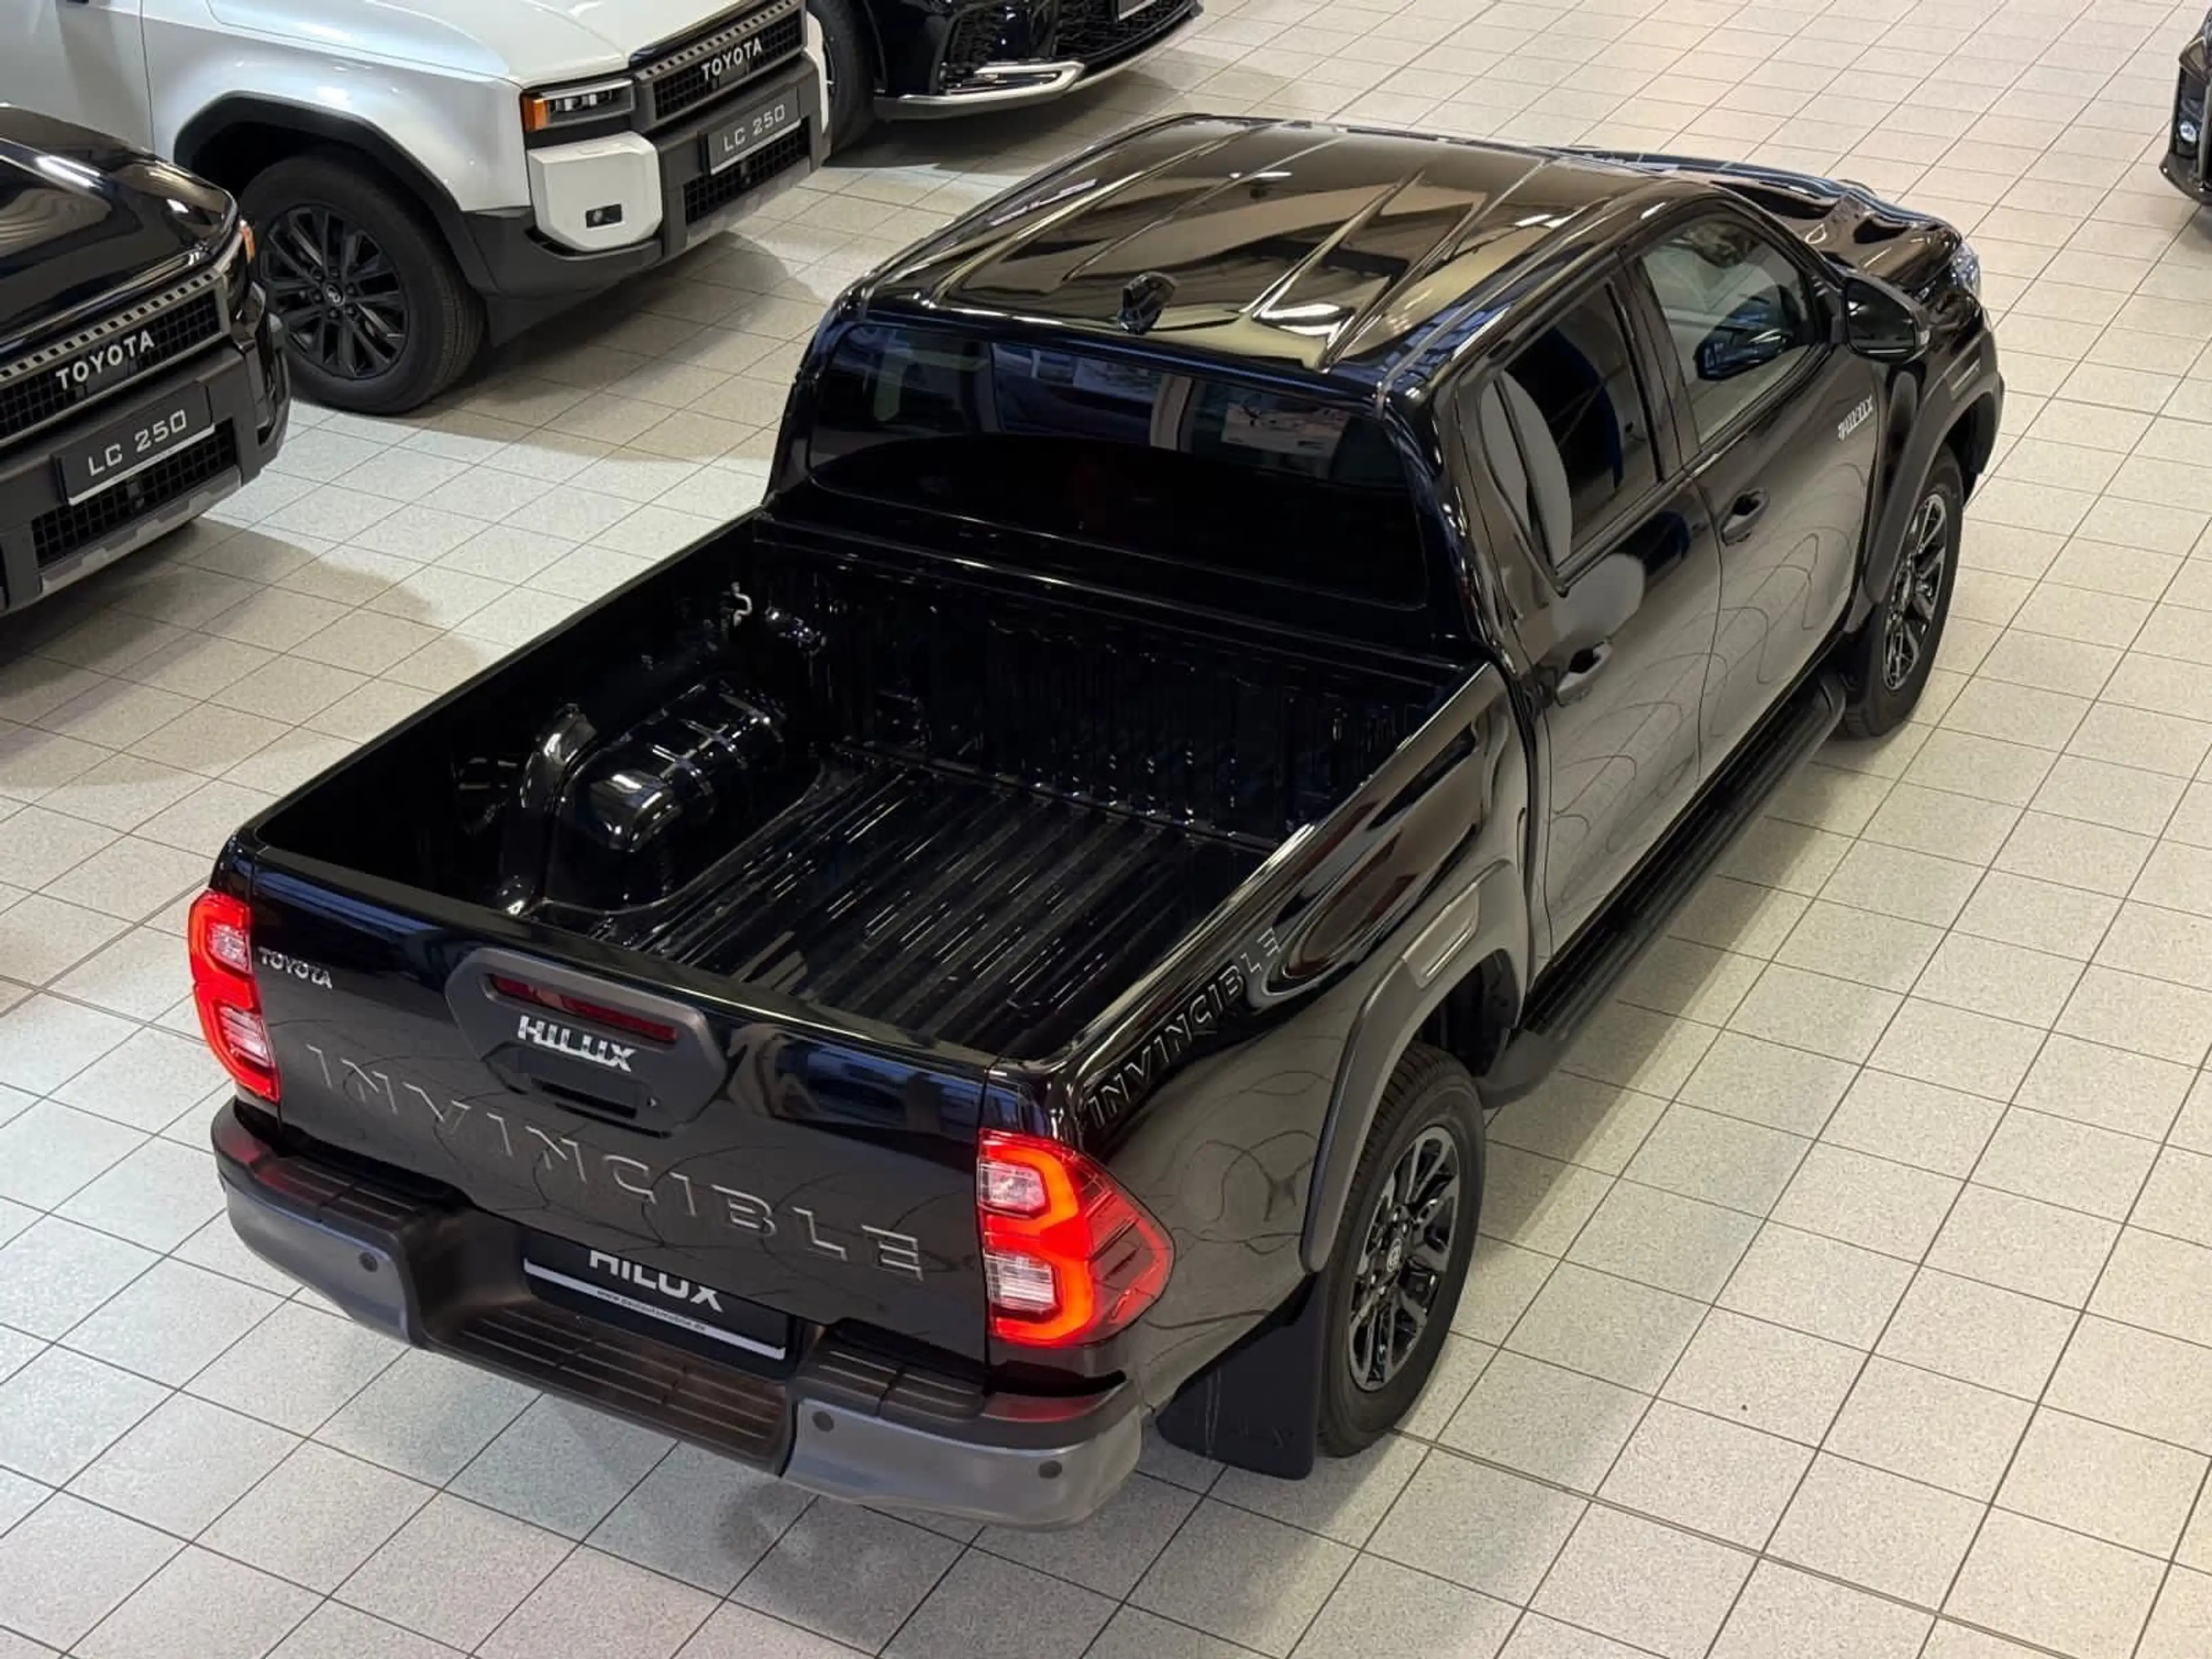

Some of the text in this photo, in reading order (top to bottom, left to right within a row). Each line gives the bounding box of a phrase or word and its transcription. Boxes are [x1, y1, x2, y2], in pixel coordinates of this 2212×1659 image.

[701, 36, 763, 81] TOYOTA
[724, 104, 785, 151] LC 250
[55, 330, 155, 391] TOYOTA
[88, 409, 187, 476] LC 250
[258, 946, 333, 990] TOYOTA
[517, 1014, 637, 1073] HILUX
[1088, 927, 1282, 1126] INVINCIBLE
[306, 1044, 925, 1282] INVINCIBLE
